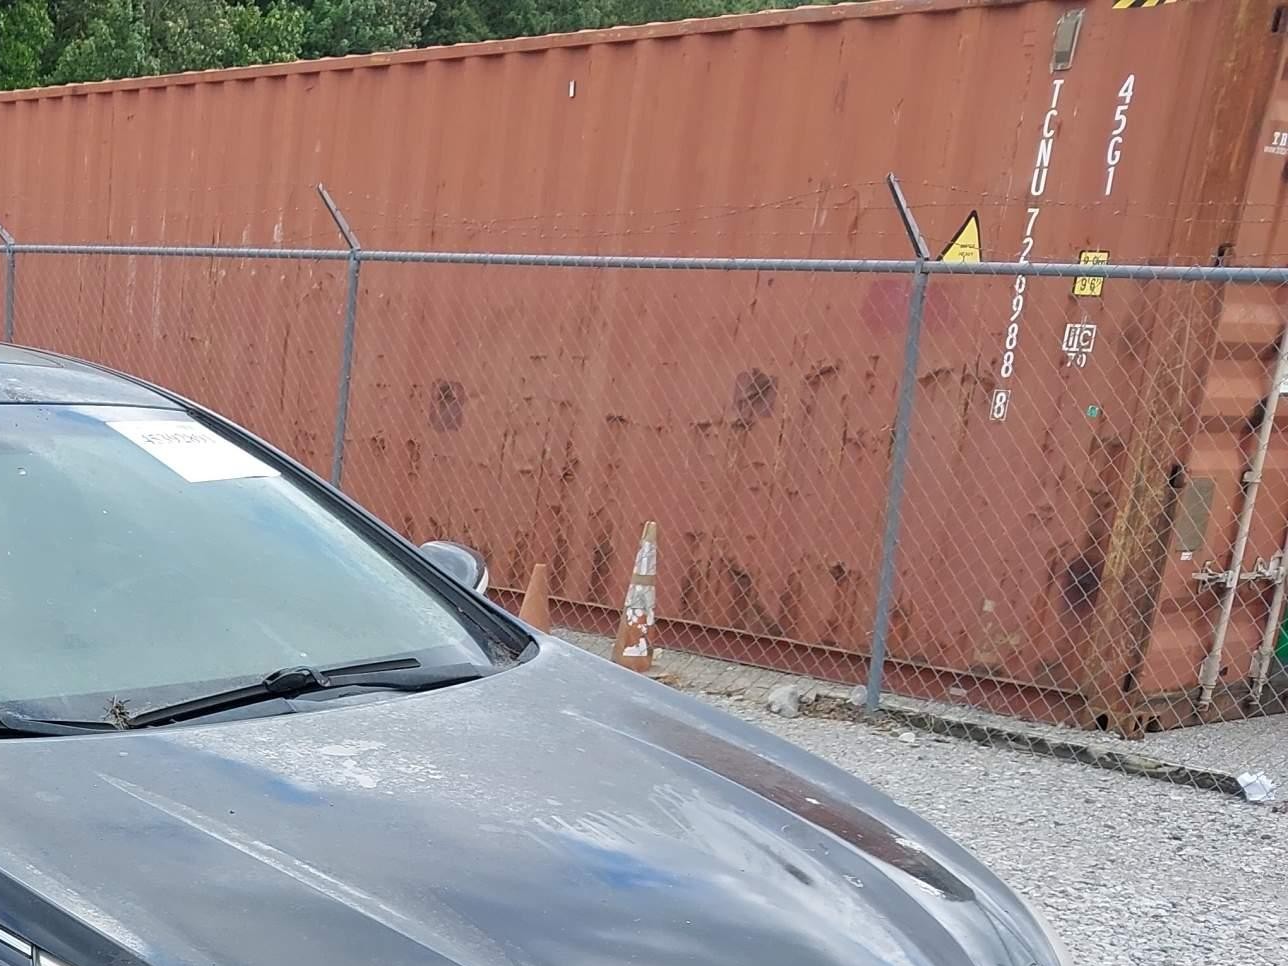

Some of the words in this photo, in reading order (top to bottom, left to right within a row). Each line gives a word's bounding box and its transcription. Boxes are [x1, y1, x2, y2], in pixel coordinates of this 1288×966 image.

[1030, 79, 1064, 196] TCNU
[1105, 74, 1135, 196] 45G1
[992, 391, 1009, 419] 8
